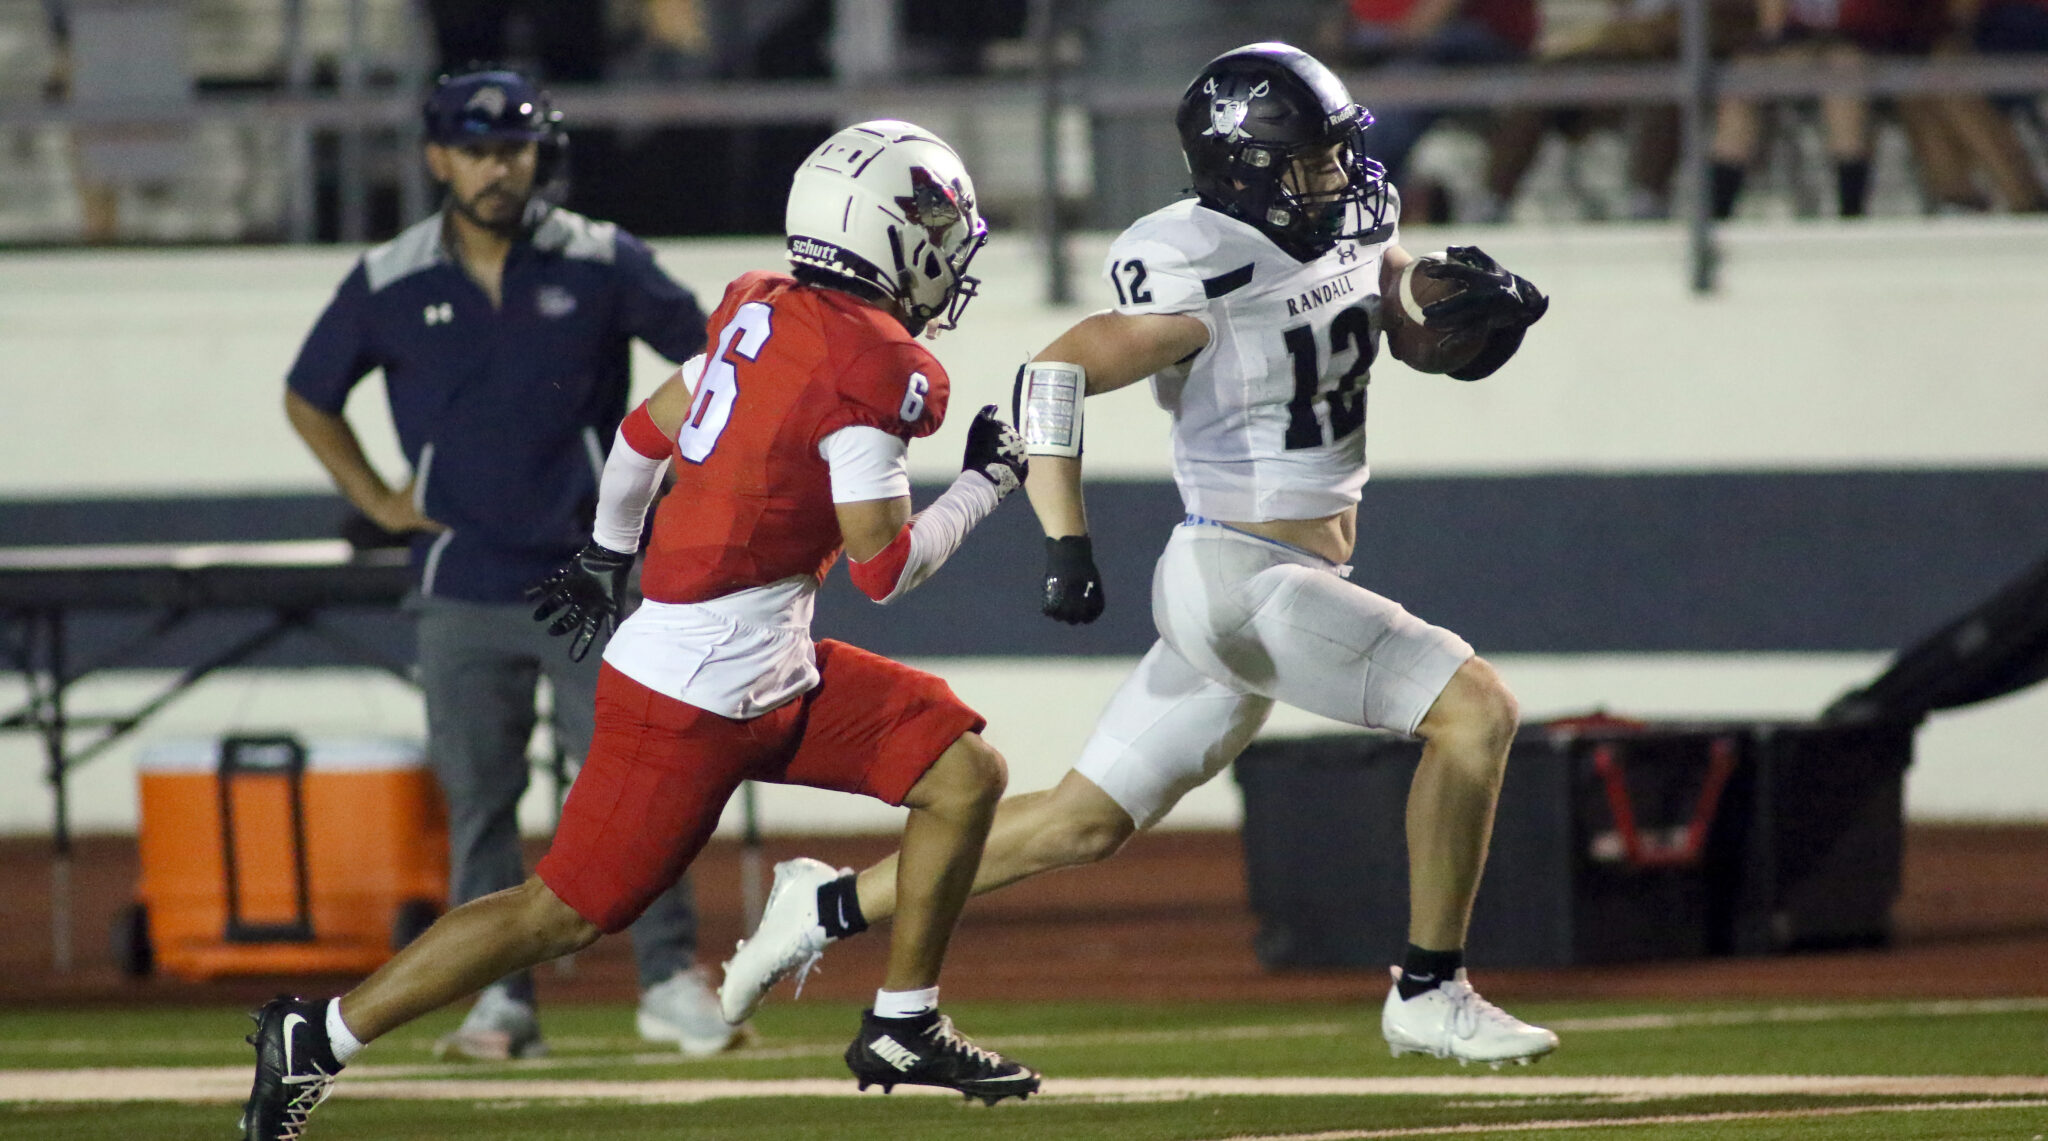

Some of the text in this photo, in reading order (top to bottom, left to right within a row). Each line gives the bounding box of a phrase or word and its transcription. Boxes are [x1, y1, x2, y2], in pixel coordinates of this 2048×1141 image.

[793, 239, 838, 261] schutt
[1111, 259, 1152, 305] 12
[1286, 275, 1354, 317] RANDALL
[678, 301, 774, 465] 6
[899, 371, 929, 422] 6
[1283, 306, 1374, 450] 12
[868, 1034, 921, 1073] NIKE
